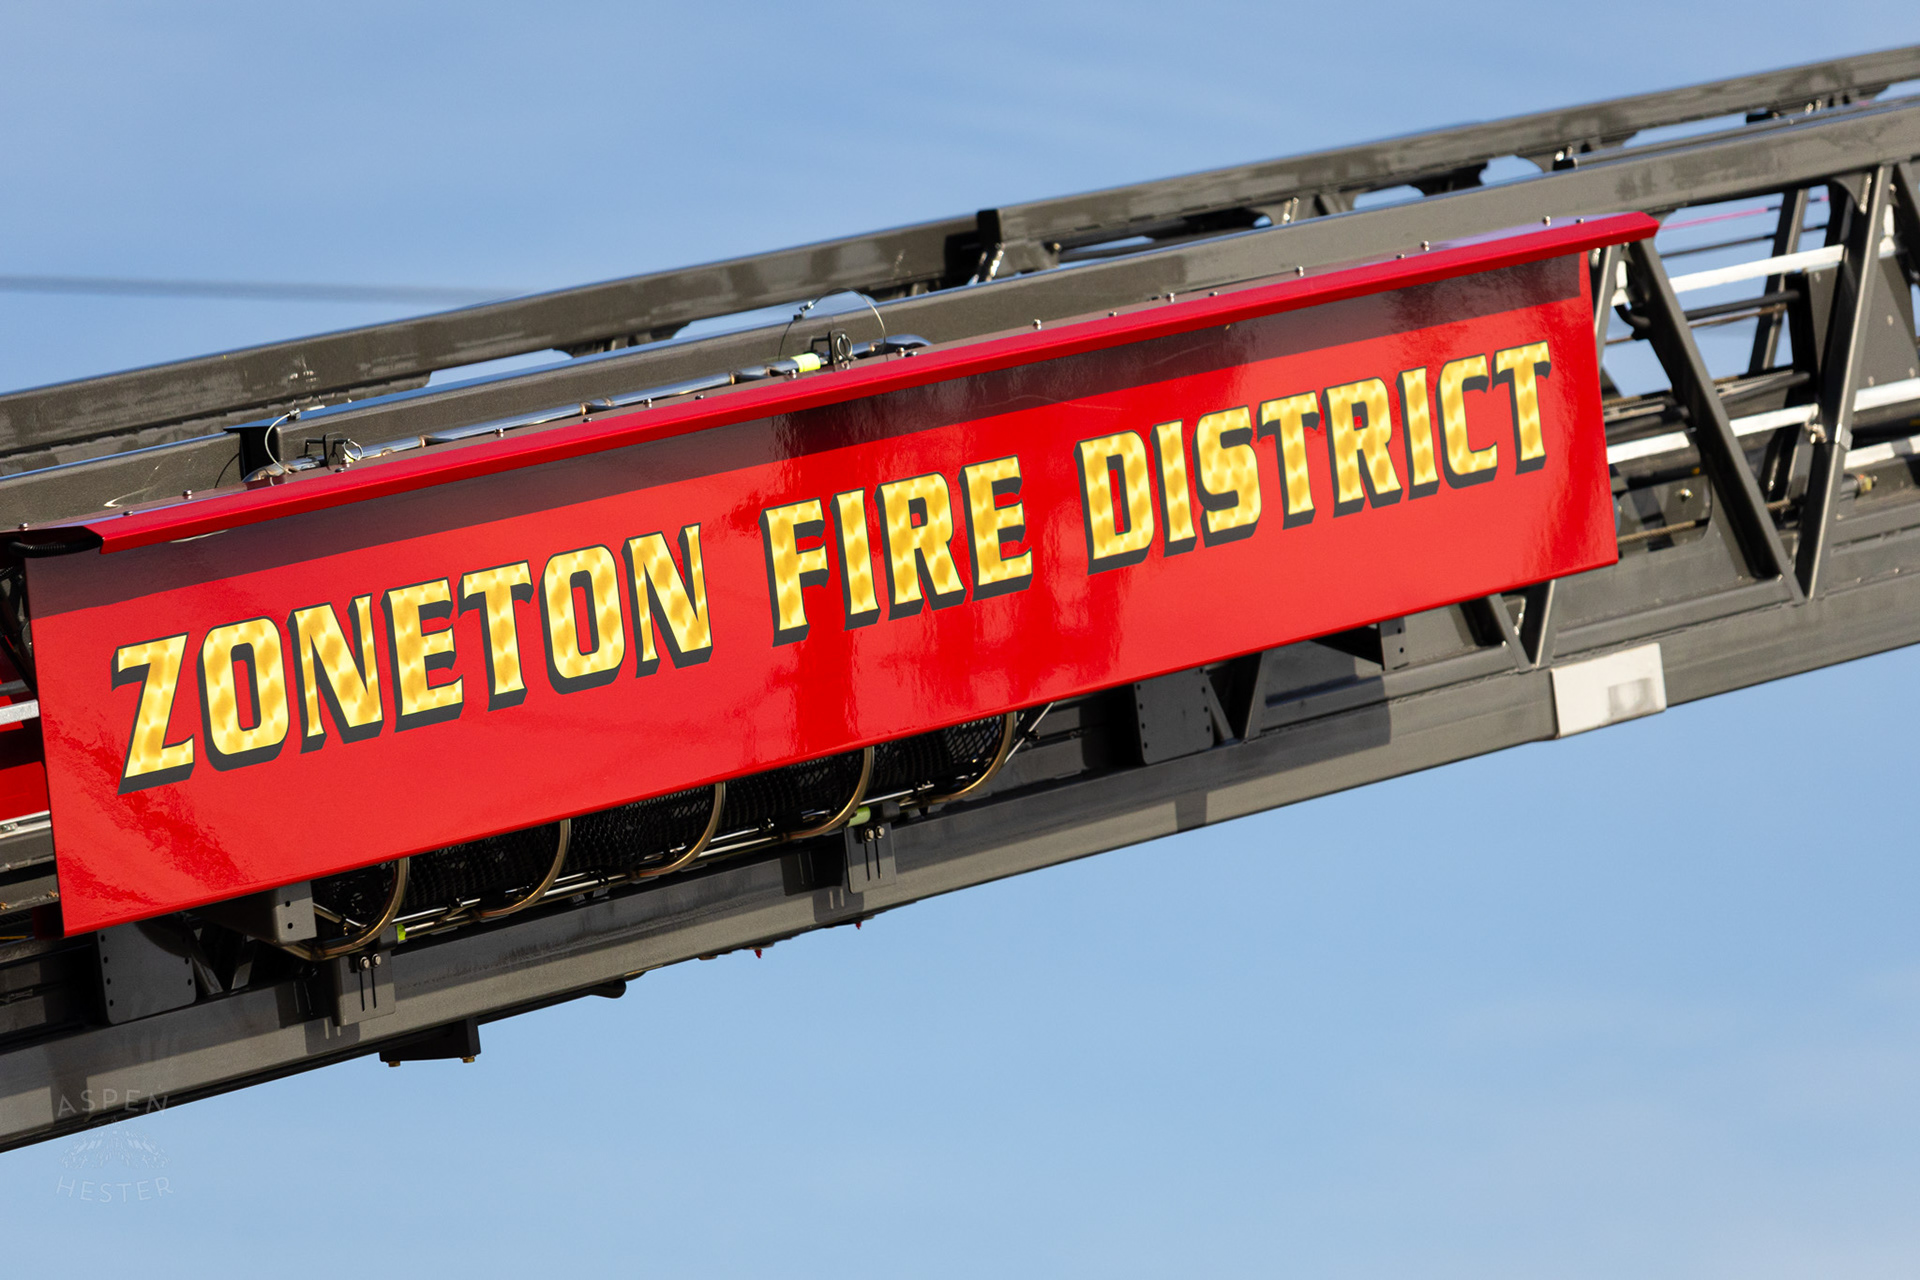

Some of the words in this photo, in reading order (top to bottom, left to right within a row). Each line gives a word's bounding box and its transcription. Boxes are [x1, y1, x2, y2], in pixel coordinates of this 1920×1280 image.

[112, 523, 713, 792] ZONETON
[761, 455, 1033, 643] FIRE
[1076, 341, 1551, 572] DISTRICT
